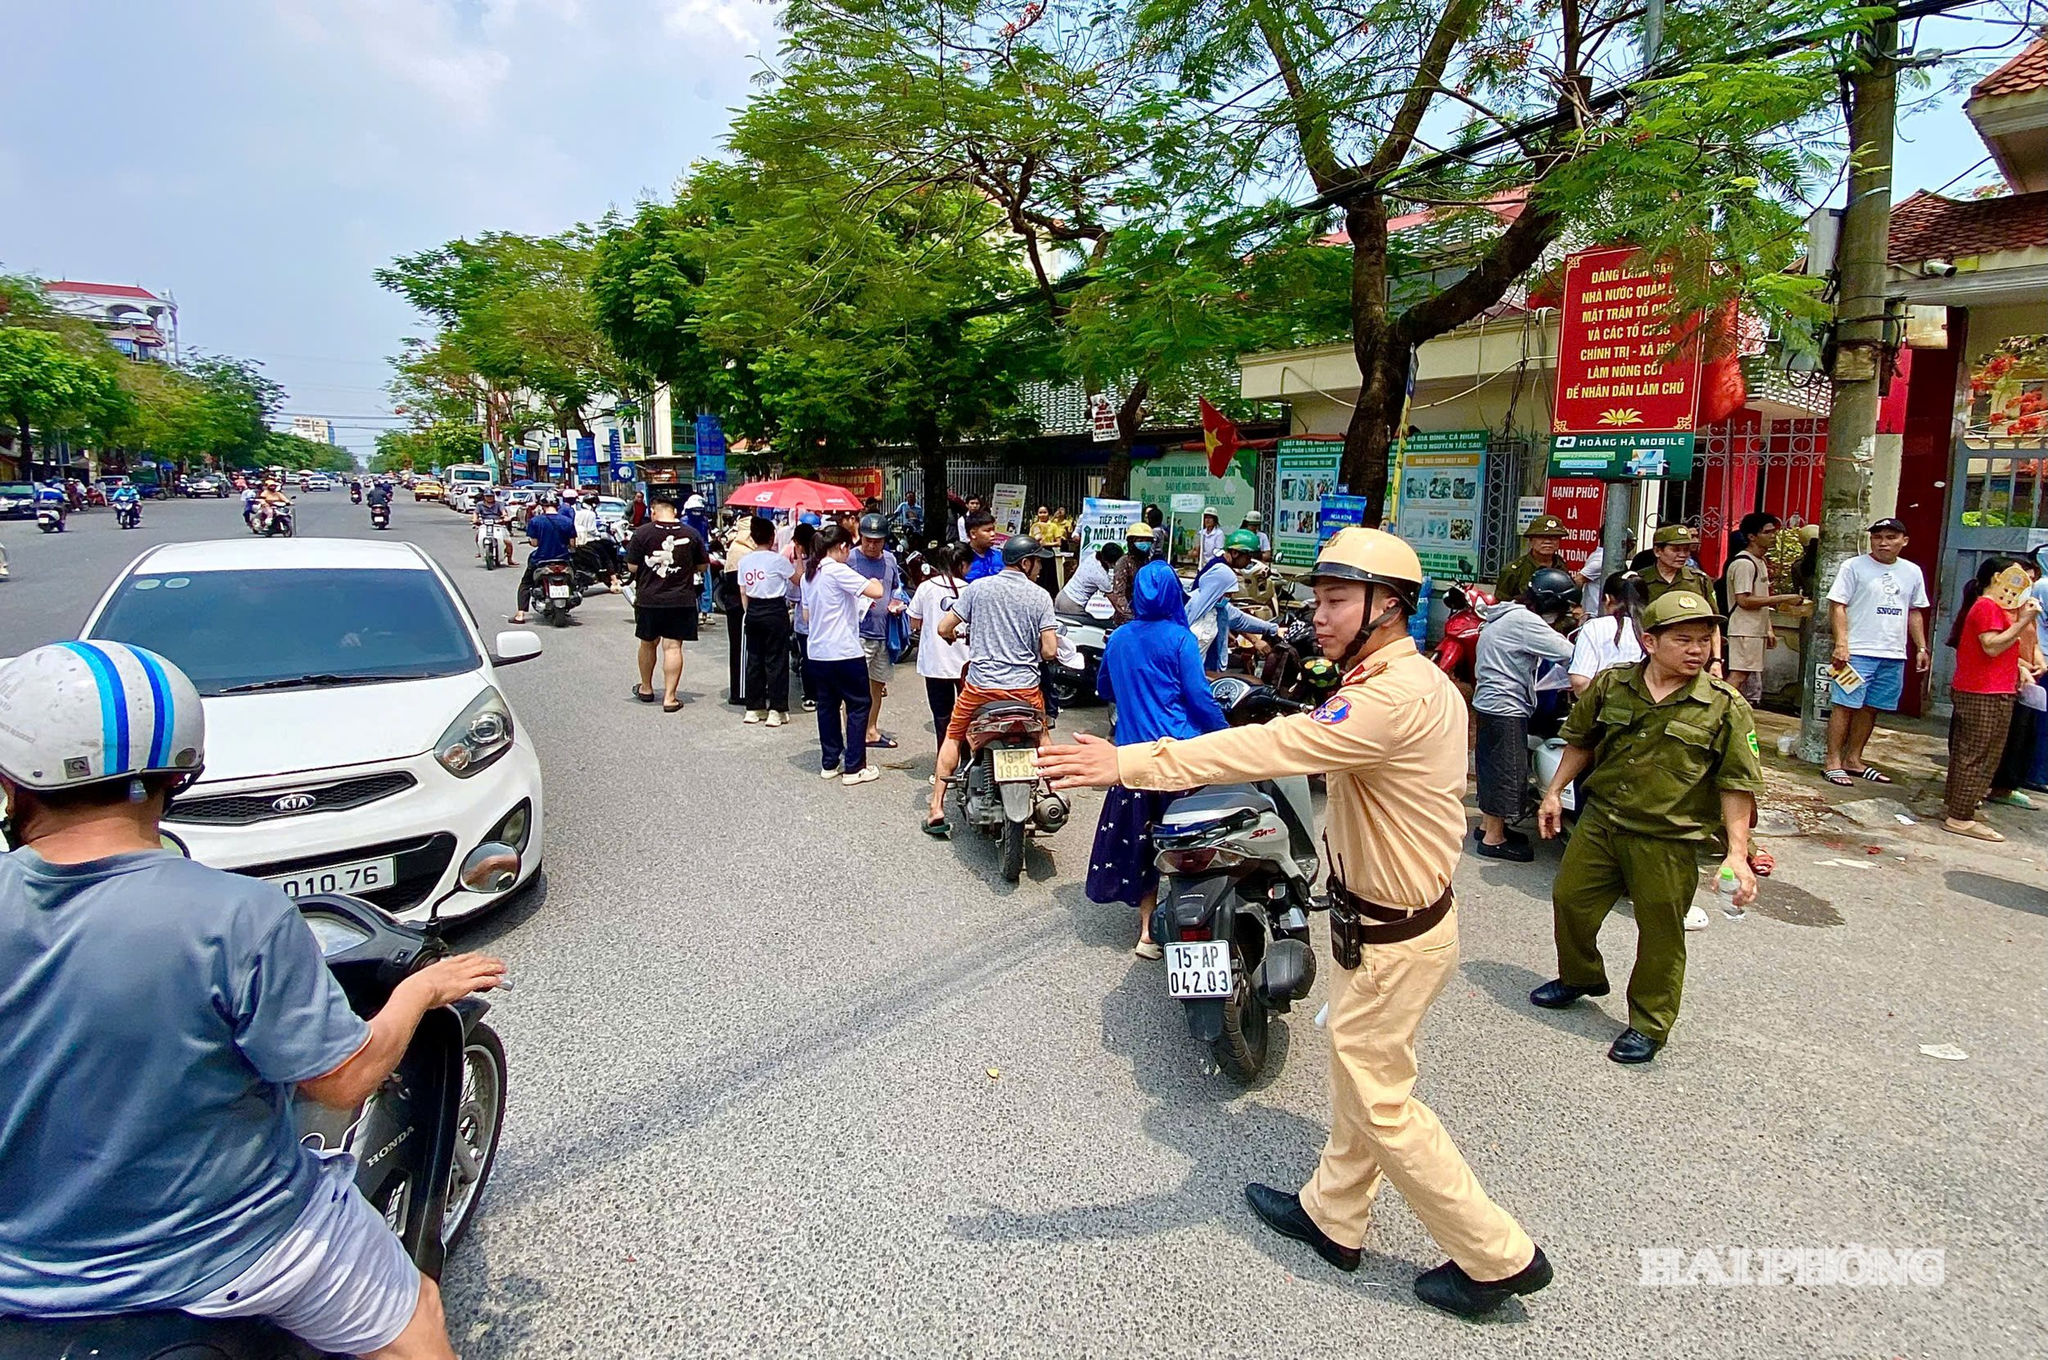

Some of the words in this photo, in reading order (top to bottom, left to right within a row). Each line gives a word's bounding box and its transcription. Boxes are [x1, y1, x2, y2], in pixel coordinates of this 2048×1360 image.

[1591, 267, 1619, 284] ĐẢNG
[1581, 287, 1602, 304] NHÀ
[1605, 285, 1634, 301] NƯỚC
[1582, 307, 1604, 324] MẶT
[1606, 305, 1633, 322] TRẬN
[1635, 300, 1651, 316] TỔ
[1588, 327, 1601, 341] VÀ
[1603, 326, 1624, 340] CÁC
[1627, 321, 1641, 338] TỔ
[1580, 346, 1611, 361] CHÍNH
[1614, 346, 1630, 361] TRỊ
[1639, 341, 1654, 356] XÃ
[1587, 365, 1609, 379] LÀM
[1611, 362, 1641, 378] NÒNG
[1566, 382, 1581, 399] ĐỂ
[1581, 383, 1610, 398] NHÂN
[1612, 382, 1634, 397] DÂN
[1636, 381, 1659, 396] LÀM
[1662, 378, 1685, 394] CHỦ
[1579, 437, 1617, 447] HOÀNG
[1620, 436, 1636, 446] HÀ
[1640, 437, 1685, 446] MOBILE
[1552, 486, 1574, 500] HẠNH
[1576, 485, 1599, 498] PHÚC
[1567, 505, 1578, 519] LÀ
[1093, 525, 1115, 540] MÙA
[1579, 529, 1597, 543] HỌC
[1567, 548, 1588, 561] TOÀN
[279, 796, 309, 810] KIA
[1175, 945, 1219, 969] 15-AP
[1170, 970, 1229, 994] 042.03
[365, 1125, 415, 1168] HONDA
